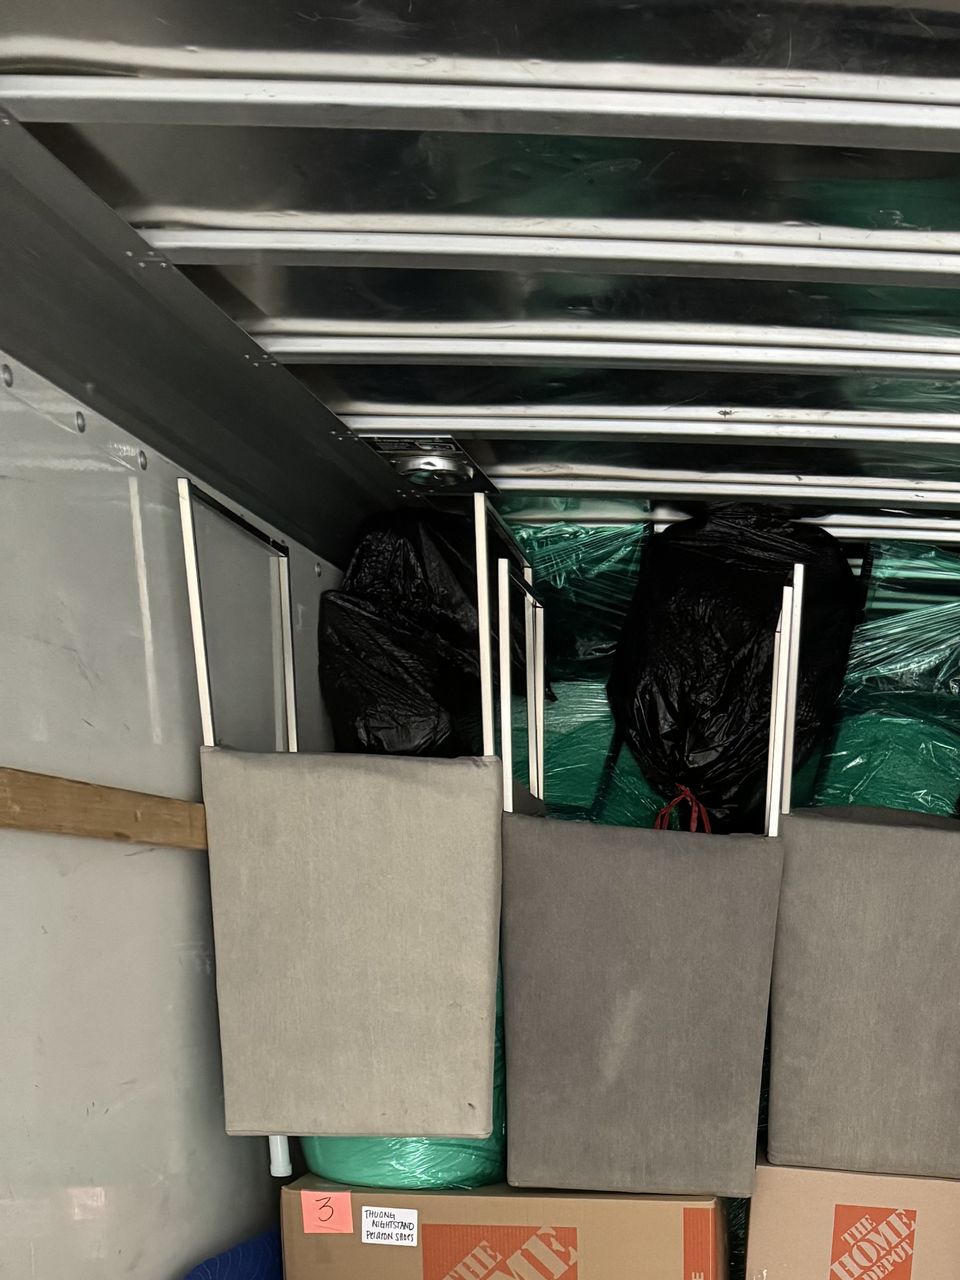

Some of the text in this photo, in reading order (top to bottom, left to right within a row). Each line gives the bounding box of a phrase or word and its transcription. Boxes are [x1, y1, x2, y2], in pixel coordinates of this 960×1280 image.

[315, 1197, 334, 1222] 3
[372, 1220, 414, 1230] NIGHTSTAND
[840, 1214, 876, 1245] THE
